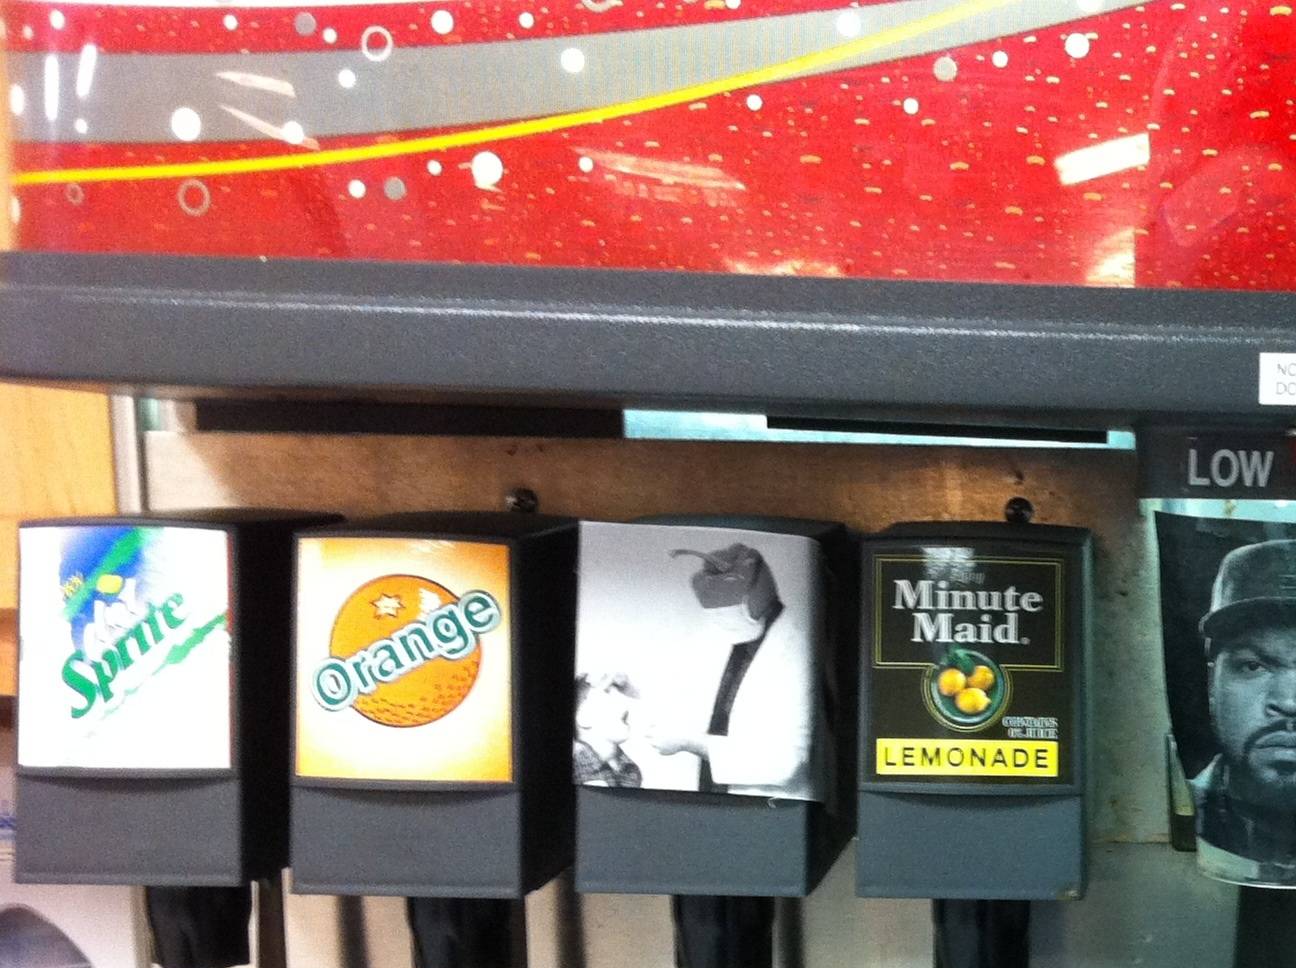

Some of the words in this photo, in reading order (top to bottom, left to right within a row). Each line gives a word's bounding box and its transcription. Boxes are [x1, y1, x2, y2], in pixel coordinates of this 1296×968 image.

[1187, 448, 1274, 488] LOW
[892, 579, 1044, 613] Minute
[61, 592, 186, 719] Sprite
[314, 591, 500, 710] Orange
[884, 746, 1050, 769] LEMONADE
